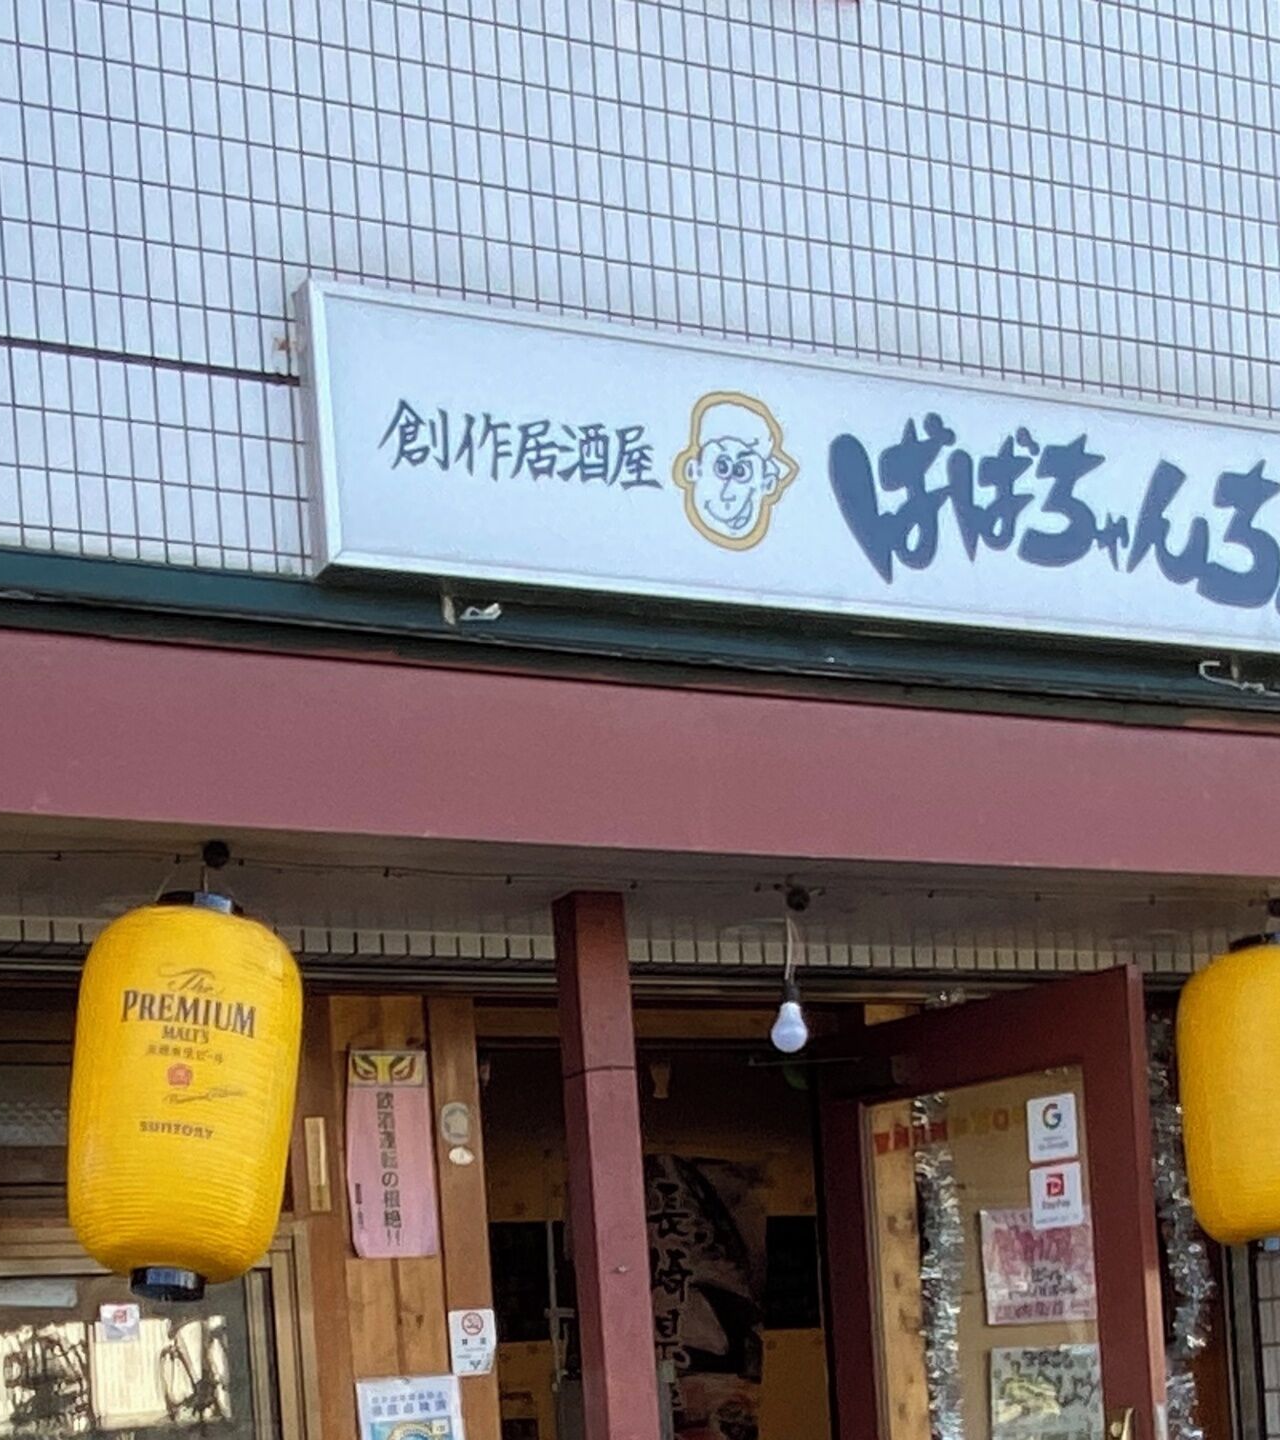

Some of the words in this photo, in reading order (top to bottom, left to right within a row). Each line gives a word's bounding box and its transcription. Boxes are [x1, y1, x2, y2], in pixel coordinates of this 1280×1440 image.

[376, 397, 664, 491] 創作居酒屋
[121, 989, 257, 1039] PREMIUM
[139, 1120, 214, 1140] SUNTORY
